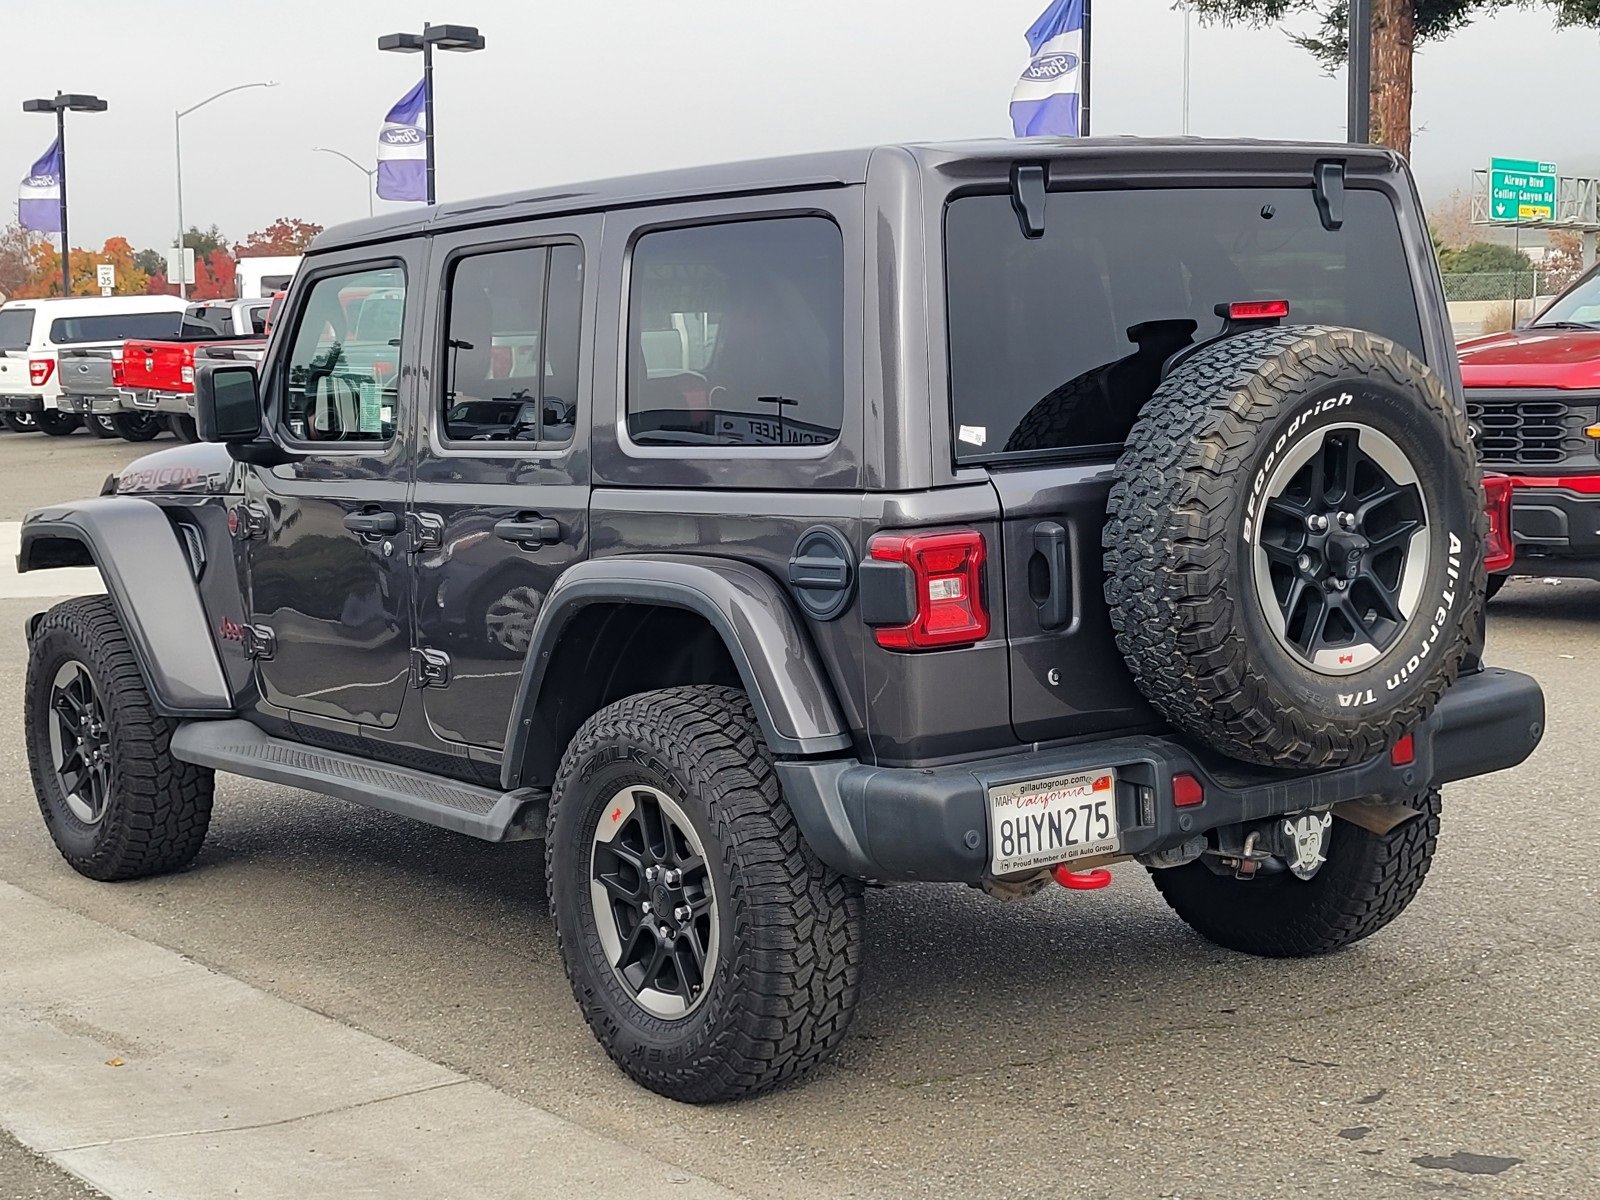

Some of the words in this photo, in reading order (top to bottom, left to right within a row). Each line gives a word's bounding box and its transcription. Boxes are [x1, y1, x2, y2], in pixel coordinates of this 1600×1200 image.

[1504, 174, 1527, 188] Airway
[1529, 176, 1544, 188] Blvd
[1494, 188, 1517, 199] Collier
[1518, 190, 1543, 203] Canyon
[1544, 192, 1553, 203] Rd
[1243, 391, 1354, 544] BFGoodrich
[1386, 531, 1462, 691] All-Terrain
[1338, 688, 1378, 707] T/A
[1019, 775, 1086, 795] gillautogroup.com
[1000, 800, 1110, 857] 8HYN275
[1013, 859, 1032, 868] Proud
[1033, 855, 1059, 864] Member
[1068, 849, 1079, 858] Gill
[1080, 846, 1094, 855] Auto
[1095, 844, 1114, 853] Group
